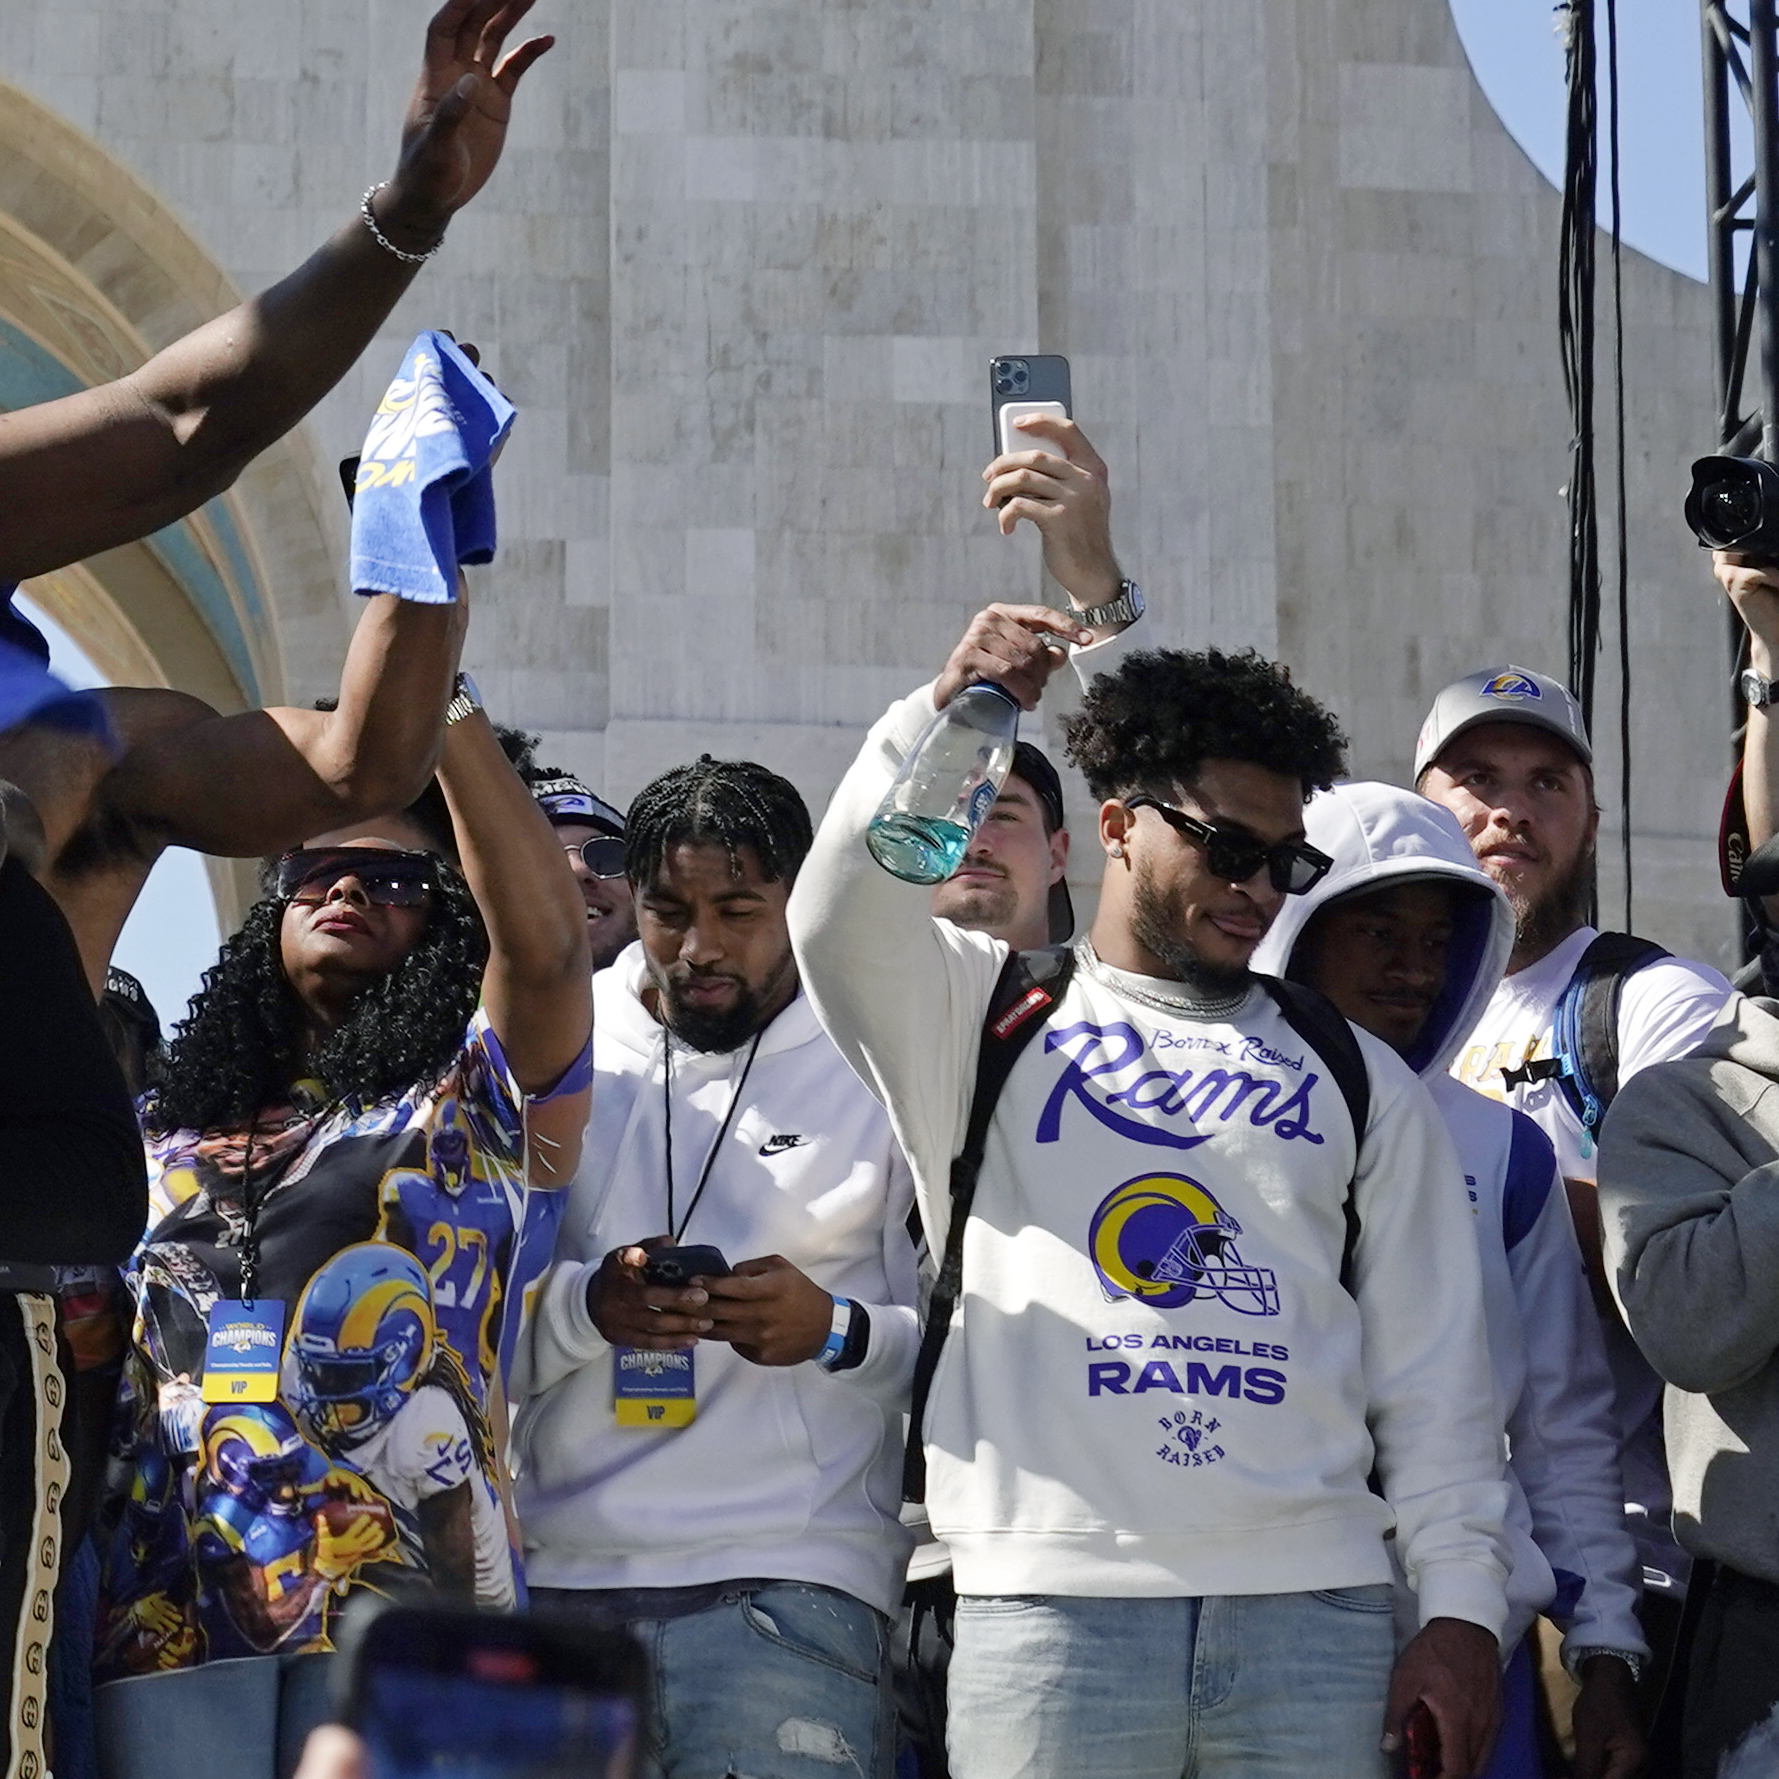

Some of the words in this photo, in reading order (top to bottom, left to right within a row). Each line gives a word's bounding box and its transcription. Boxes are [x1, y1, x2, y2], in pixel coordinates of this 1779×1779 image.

[1240, 1036, 1304, 1071] Raised
[1036, 1021, 1324, 1150] Rams
[769, 1134, 802, 1146] NIKE
[427, 1222, 487, 1310] 27
[212, 1329, 277, 1348] CHAMPIONS
[1086, 1334, 1143, 1351] LOS
[1151, 1335, 1289, 1361] ANGELES
[620, 1352, 690, 1371] CHAMPIONS
[231, 1380, 248, 1394] VIP
[1088, 1361, 1287, 1405] RAMS
[646, 1405, 665, 1420] VIP
[1158, 1410, 1222, 1434] BORN
[1156, 1444, 1226, 1467] RAISED
